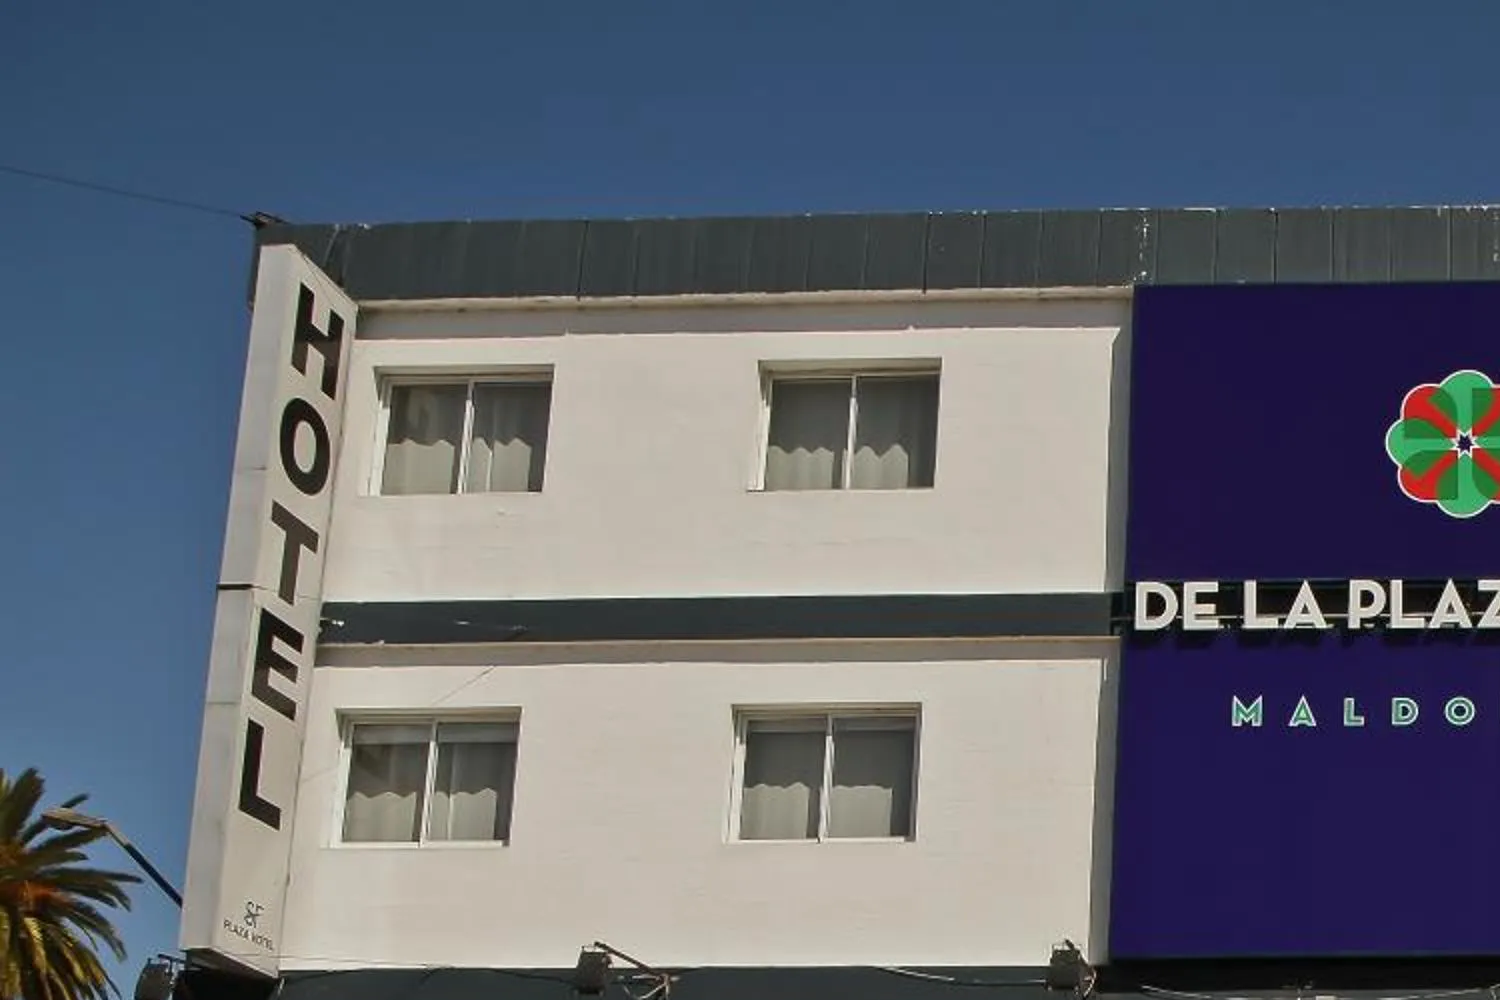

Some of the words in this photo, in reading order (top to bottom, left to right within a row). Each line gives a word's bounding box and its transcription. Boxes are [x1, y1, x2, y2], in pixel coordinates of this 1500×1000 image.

[238, 282, 344, 832] HOTEL
[1134, 580, 1219, 631] DE
[1243, 579, 1327, 630] LA
